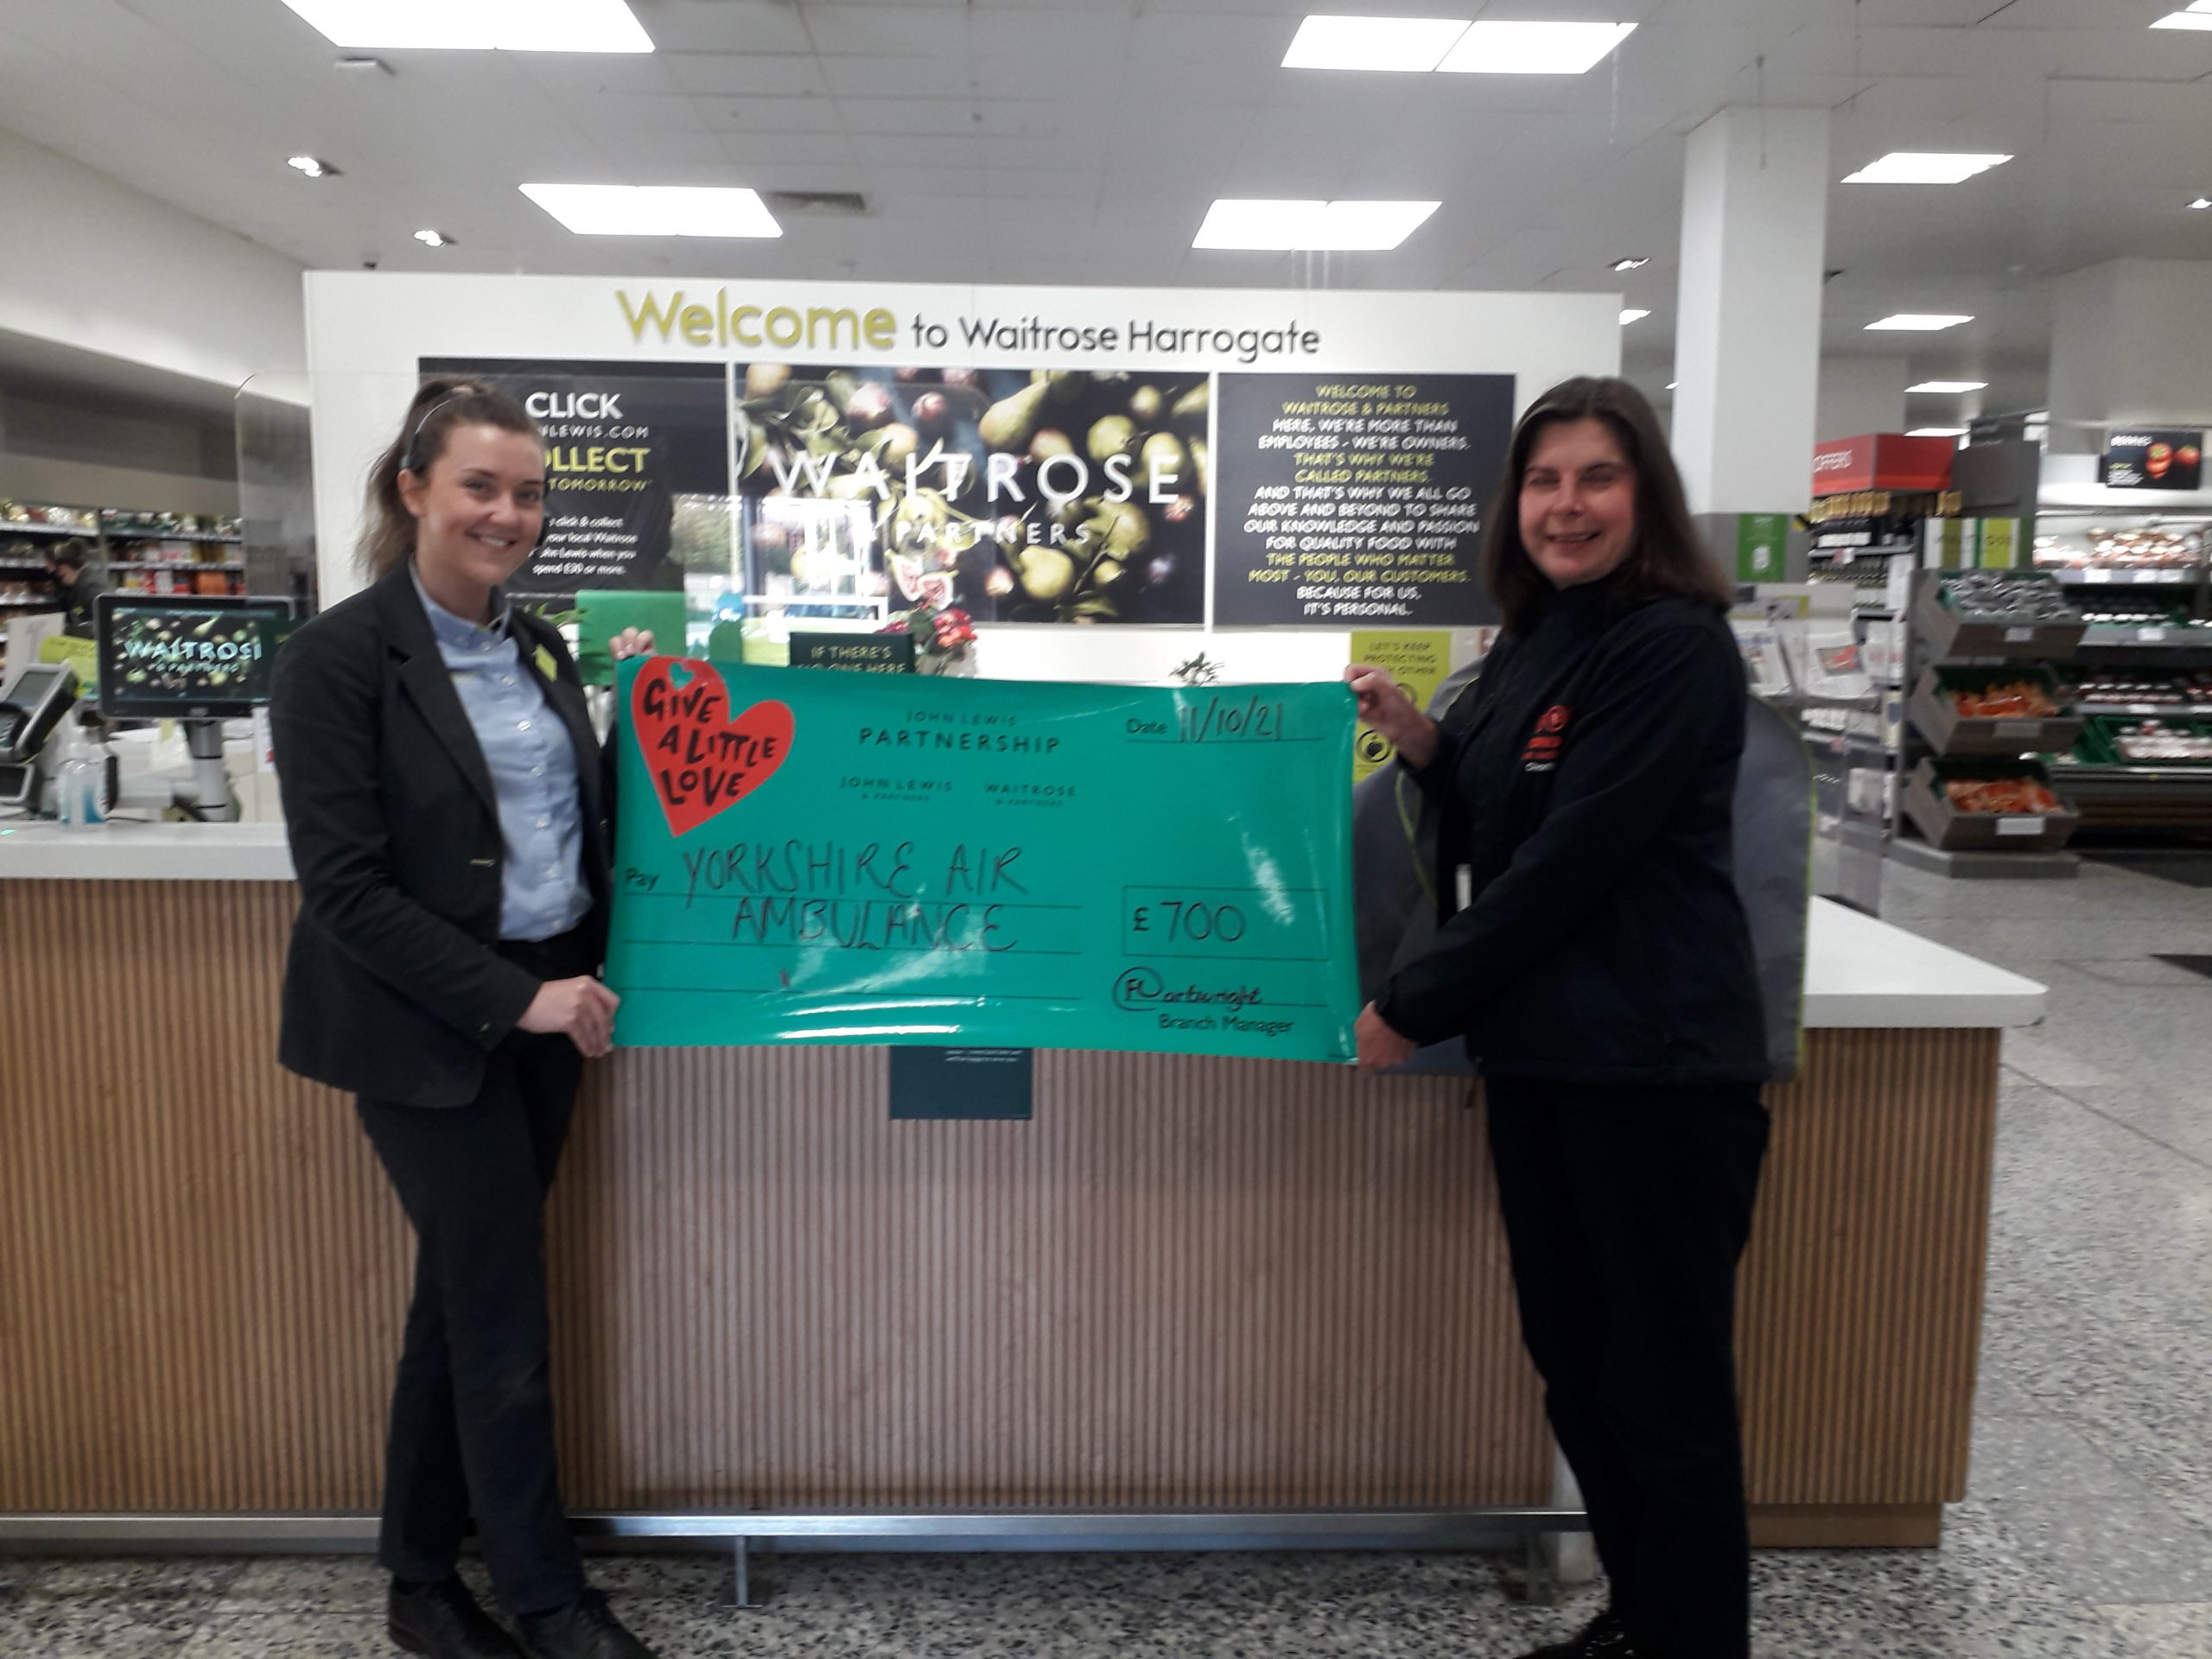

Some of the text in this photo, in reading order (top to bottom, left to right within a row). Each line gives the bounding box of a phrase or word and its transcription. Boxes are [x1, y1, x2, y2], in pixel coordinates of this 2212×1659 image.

[616, 286, 1320, 362] Welcome to Waitrose Harrogate
[1315, 385, 1417, 398] WELCOME TO
[525, 391, 624, 419] CLICK
[1281, 402, 1358, 416] WAITROSE
[1376, 402, 1450, 416] PARTNERS
[1273, 418, 1459, 433] HERE, WE'RE MORE THAN
[1258, 435, 1339, 450] EMPLOYEES
[1351, 435, 1399, 450] WE'RE
[1402, 435, 1471, 450] OWNERS.
[545, 446, 651, 473] LLECT
[1294, 452, 1435, 467] THAT'S WHY WE'RE
[771, 450, 1180, 505] WAITROSE
[1294, 469, 1432, 484] CALLED PARTNERS.
[1254, 486, 1471, 500] AND THAT'S WHY WE ALL GO
[1247, 502, 1478, 517] ABOVE AND BEYOND TO SHARE
[895, 521, 1092, 546] PARTNERS
[1243, 519, 1480, 534] OUR KNOWLEDGE AND PASSION
[1265, 537, 1458, 551] FOR QUALITY FOOD WITH
[1265, 553, 1456, 567] THE PEOPLE WHO MATTER
[1248, 569, 1291, 583] MOST
[1304, 569, 1340, 583] YOU,
[1343, 569, 1376, 583] OUR
[1380, 569, 1471, 583] CUSTOMERS.
[1296, 586, 1422, 600] BECAUSE FOR US,
[1303, 602, 1414, 616] IT'S PERSONAL.
[810, 645, 893, 659] IF THERE'S
[643, 677, 722, 724] GIVE
[906, 710, 1017, 728] JOHN LEWIS
[1126, 716, 1167, 735] Date
[1178, 695, 1285, 743] 11/10/21
[658, 724, 777, 767] A LITTLE
[858, 727, 1060, 754] PARTNERSHIP
[660, 766, 746, 807] LOVE
[840, 776, 953, 792] JOHN LEWIS
[985, 783, 1076, 798] WAITROSE
[626, 868, 659, 891] Pay
[683, 839, 1029, 910] YORKSHIRE AIR
[732, 895, 1018, 951] AMBULANCE
[1132, 907, 1150, 931] £
[1160, 901, 1246, 943] 700
[1159, 1013, 1294, 1038] Branch Manager
